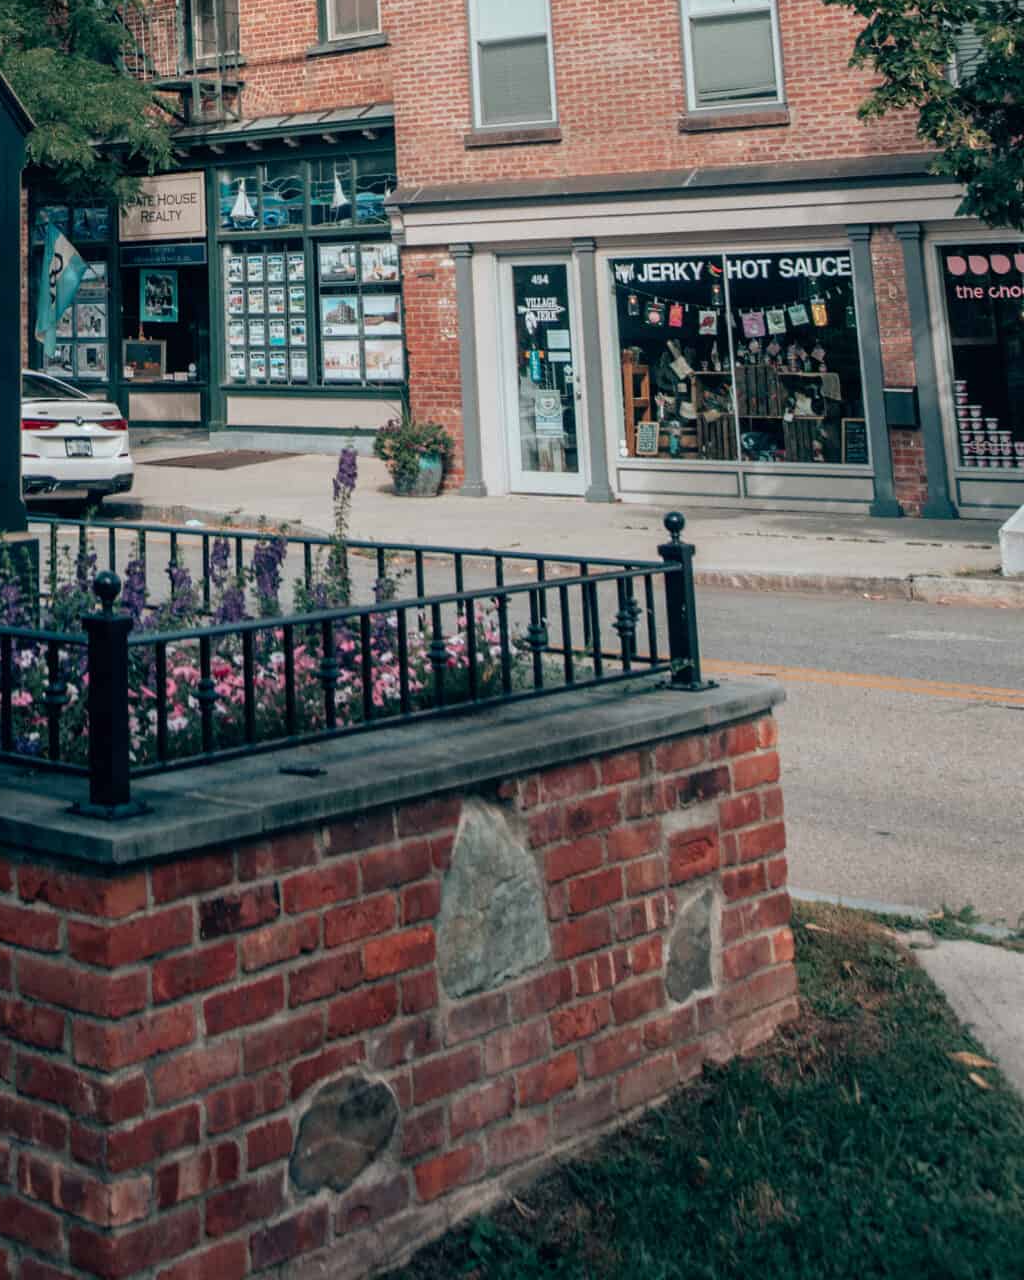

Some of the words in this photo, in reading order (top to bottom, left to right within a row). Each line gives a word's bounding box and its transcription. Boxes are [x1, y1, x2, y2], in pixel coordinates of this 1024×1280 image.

[157, 192, 198, 207] HOUSE
[140, 209, 182, 224] REALTY
[637, 261, 704, 282] JERKY
[726, 259, 772, 280] HOT
[778, 256, 852, 278] SAUCE
[955, 285, 984, 299] the
[988, 285, 1024, 299] cho
[525, 296, 558, 309] VILLAGE
